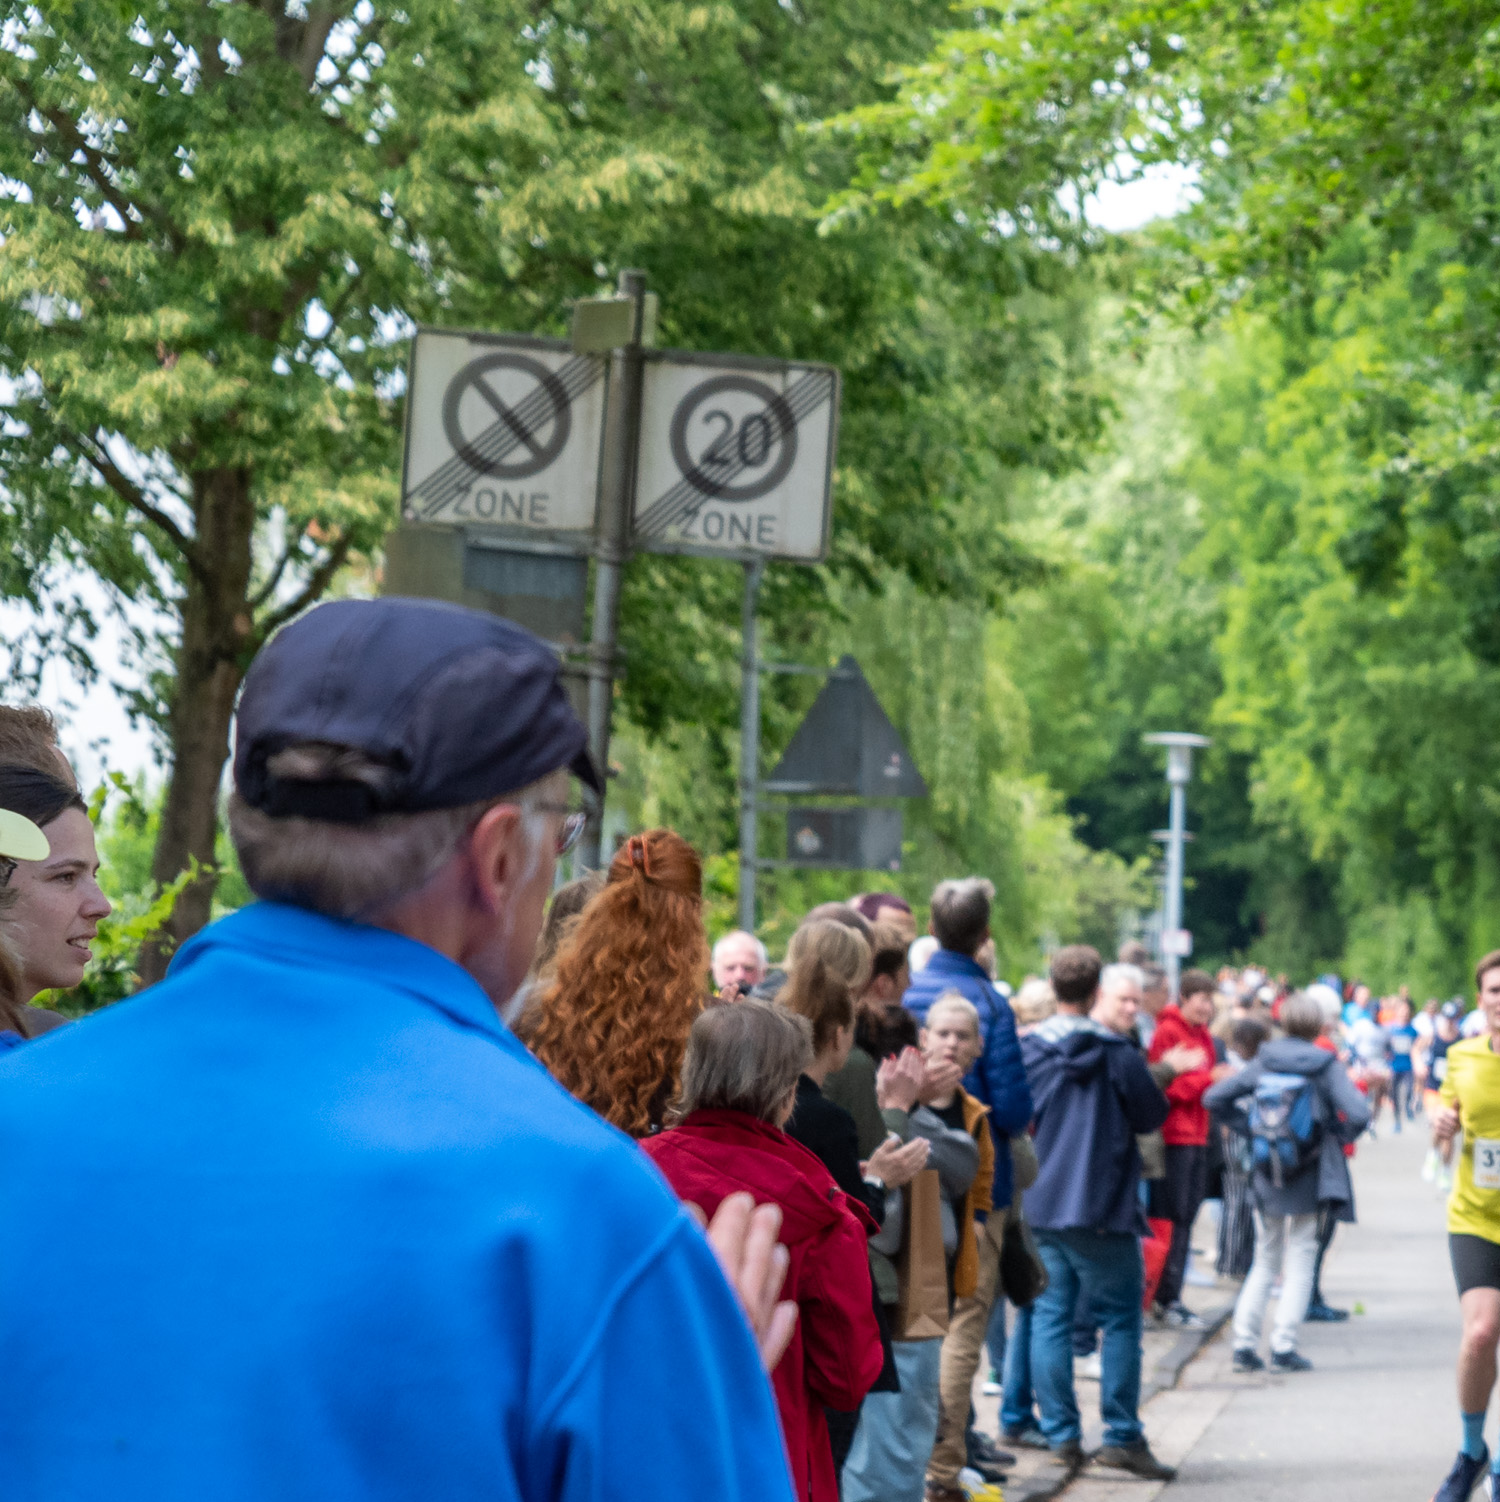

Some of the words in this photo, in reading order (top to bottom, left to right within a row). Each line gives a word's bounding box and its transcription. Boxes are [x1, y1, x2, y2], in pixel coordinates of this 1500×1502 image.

[702, 409, 771, 467] 20
[453, 485, 549, 523] ZONE
[680, 507, 777, 545] ZONE
